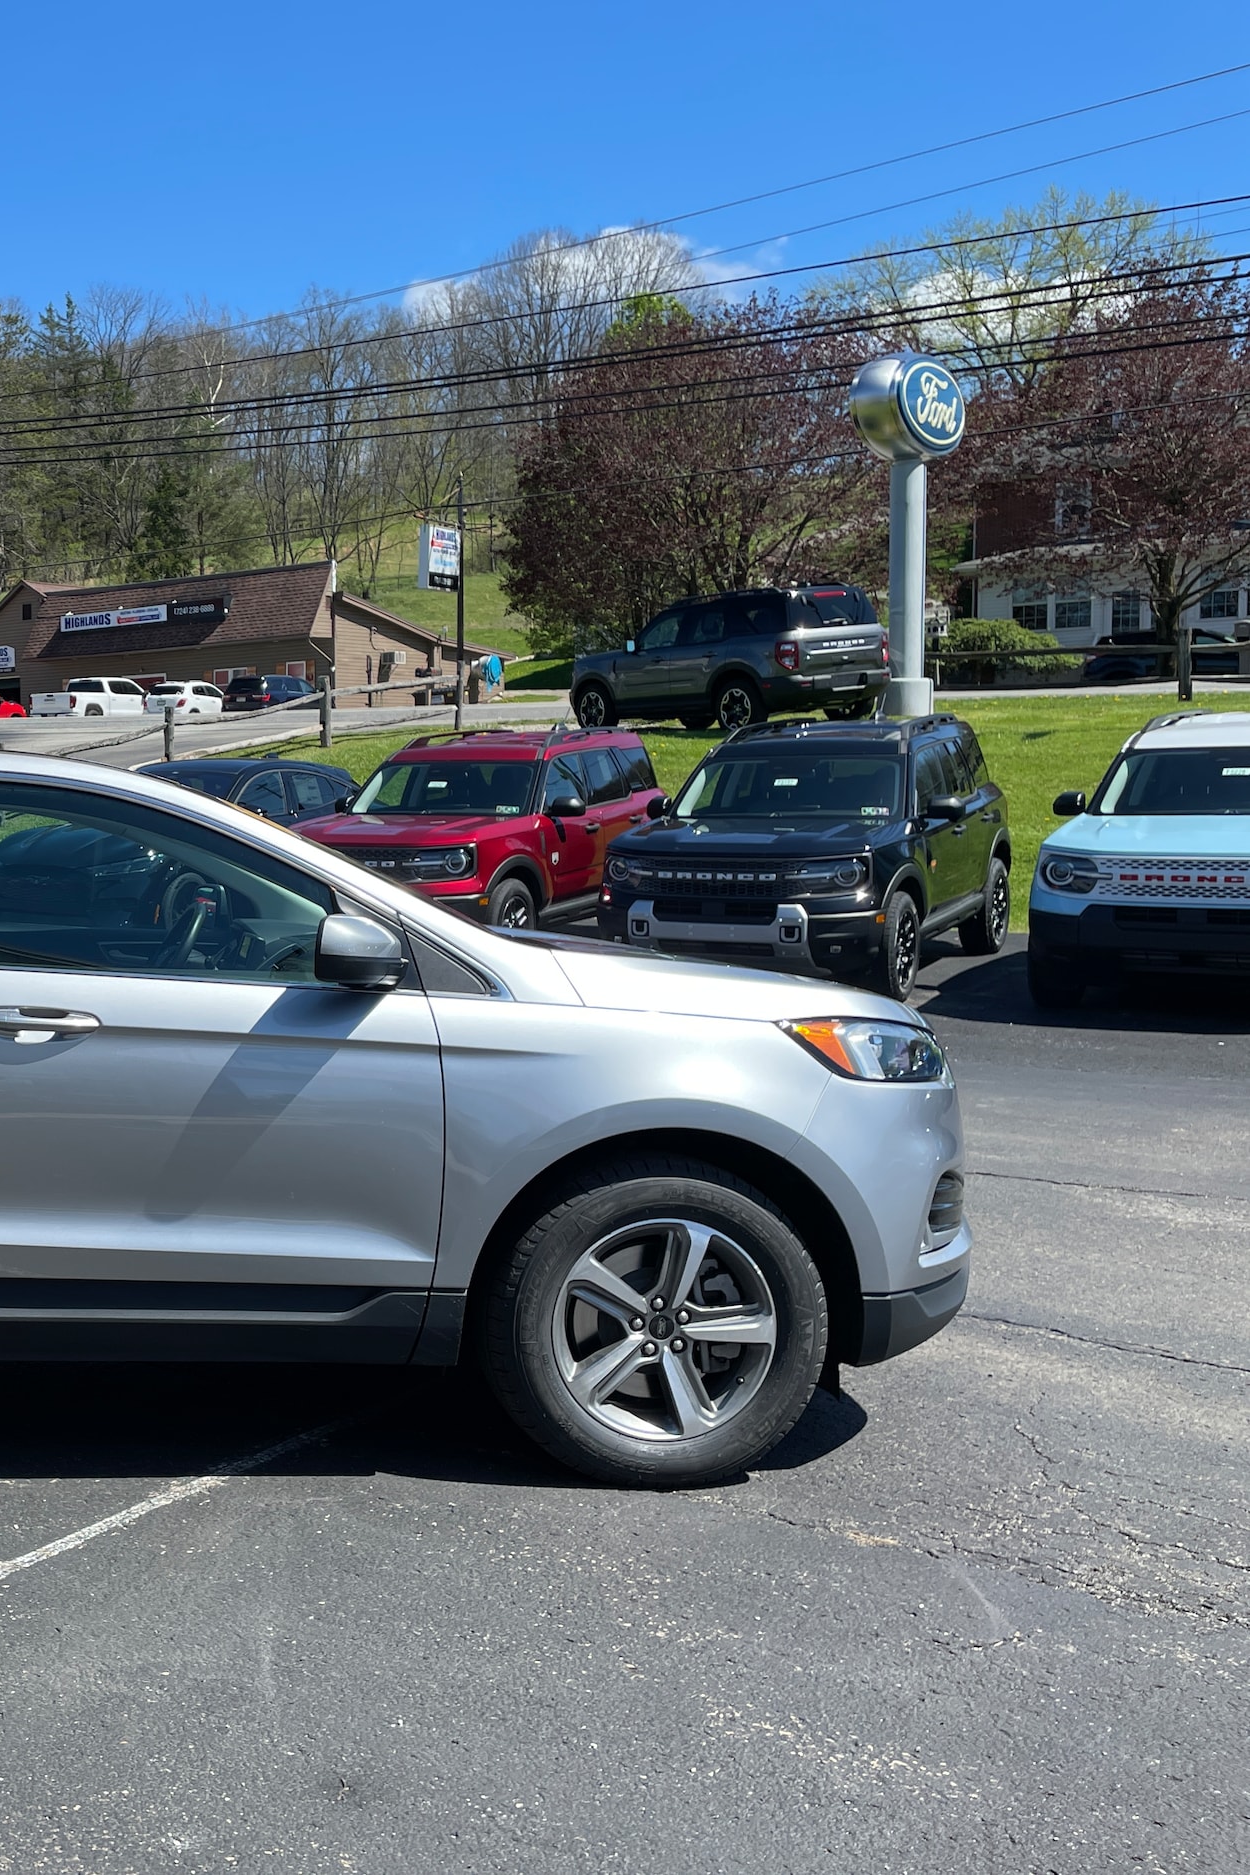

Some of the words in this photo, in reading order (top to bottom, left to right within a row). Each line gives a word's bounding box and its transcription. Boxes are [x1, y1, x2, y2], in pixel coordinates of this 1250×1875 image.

[917, 371, 958, 433] Ford
[64, 613, 111, 630] HIGHLANDS
[657, 871, 777, 881] BRONCO
